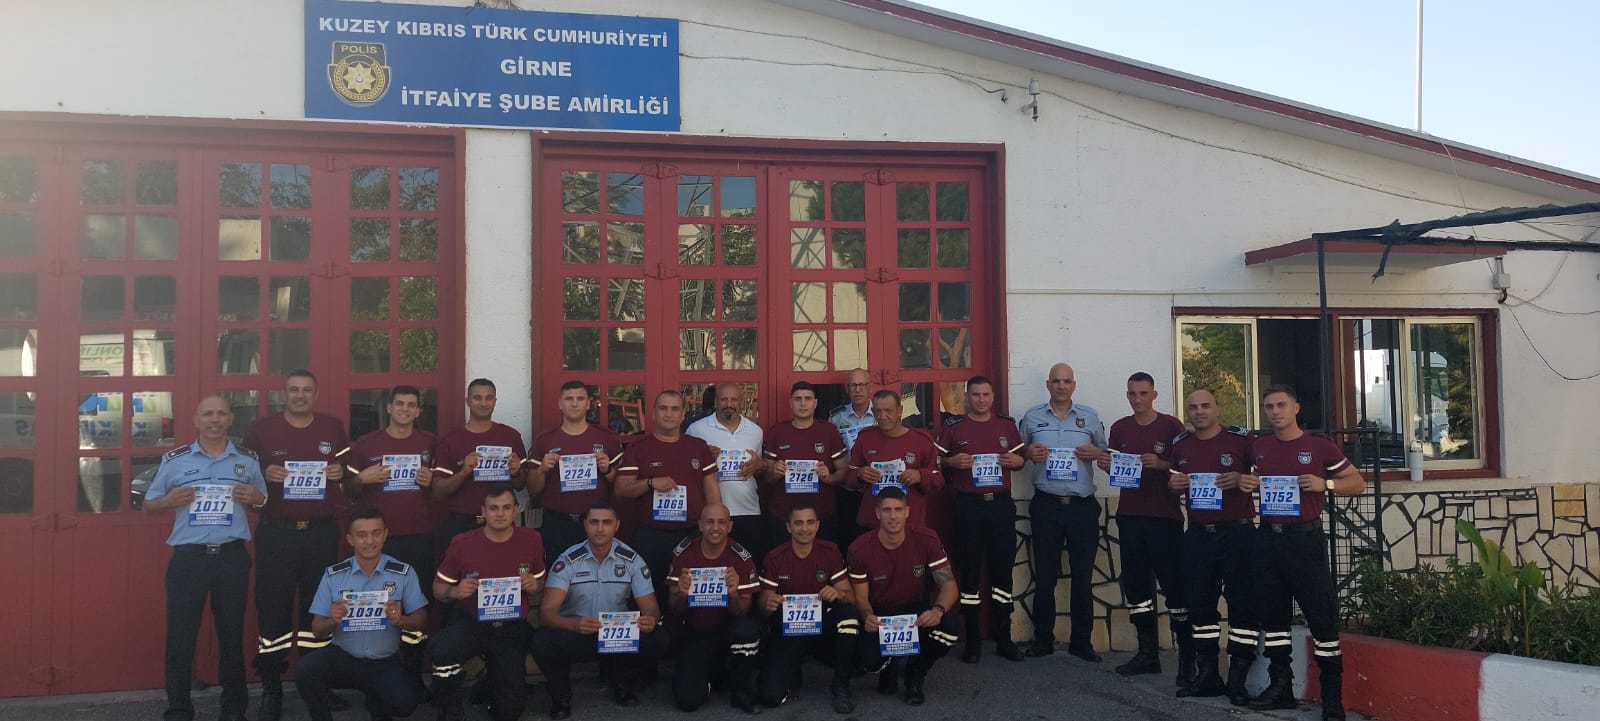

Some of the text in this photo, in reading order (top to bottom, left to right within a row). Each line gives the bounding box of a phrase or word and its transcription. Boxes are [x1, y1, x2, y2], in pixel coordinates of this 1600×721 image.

[319, 17, 669, 48] KUZEY KIBRIS TÜRK CUMHURİYETİ
[340, 44, 378, 55] POLİS
[500, 56, 572, 77] GİRNE
[400, 86, 670, 116] İTFAİYE ŞUBE AMİRLİĞİ
[477, 459, 508, 470] 1062
[1048, 460, 1074, 471] 3732
[564, 468, 593, 480] 2724
[788, 472, 814, 483] 2726
[975, 466, 1000, 477] 3730
[1113, 466, 1138, 477] 3747
[287, 475, 322, 487] 1063
[1191, 487, 1217, 498] 3753
[1264, 491, 1294, 503] 3752
[194, 500, 228, 513] 1017
[656, 498, 685, 510] 1069
[692, 582, 724, 594] 1055
[481, 593, 515, 607] 3748
[347, 606, 384, 619] 1030
[787, 610, 816, 622] 3741
[602, 627, 631, 640] 3731
[884, 631, 913, 643] 3743
